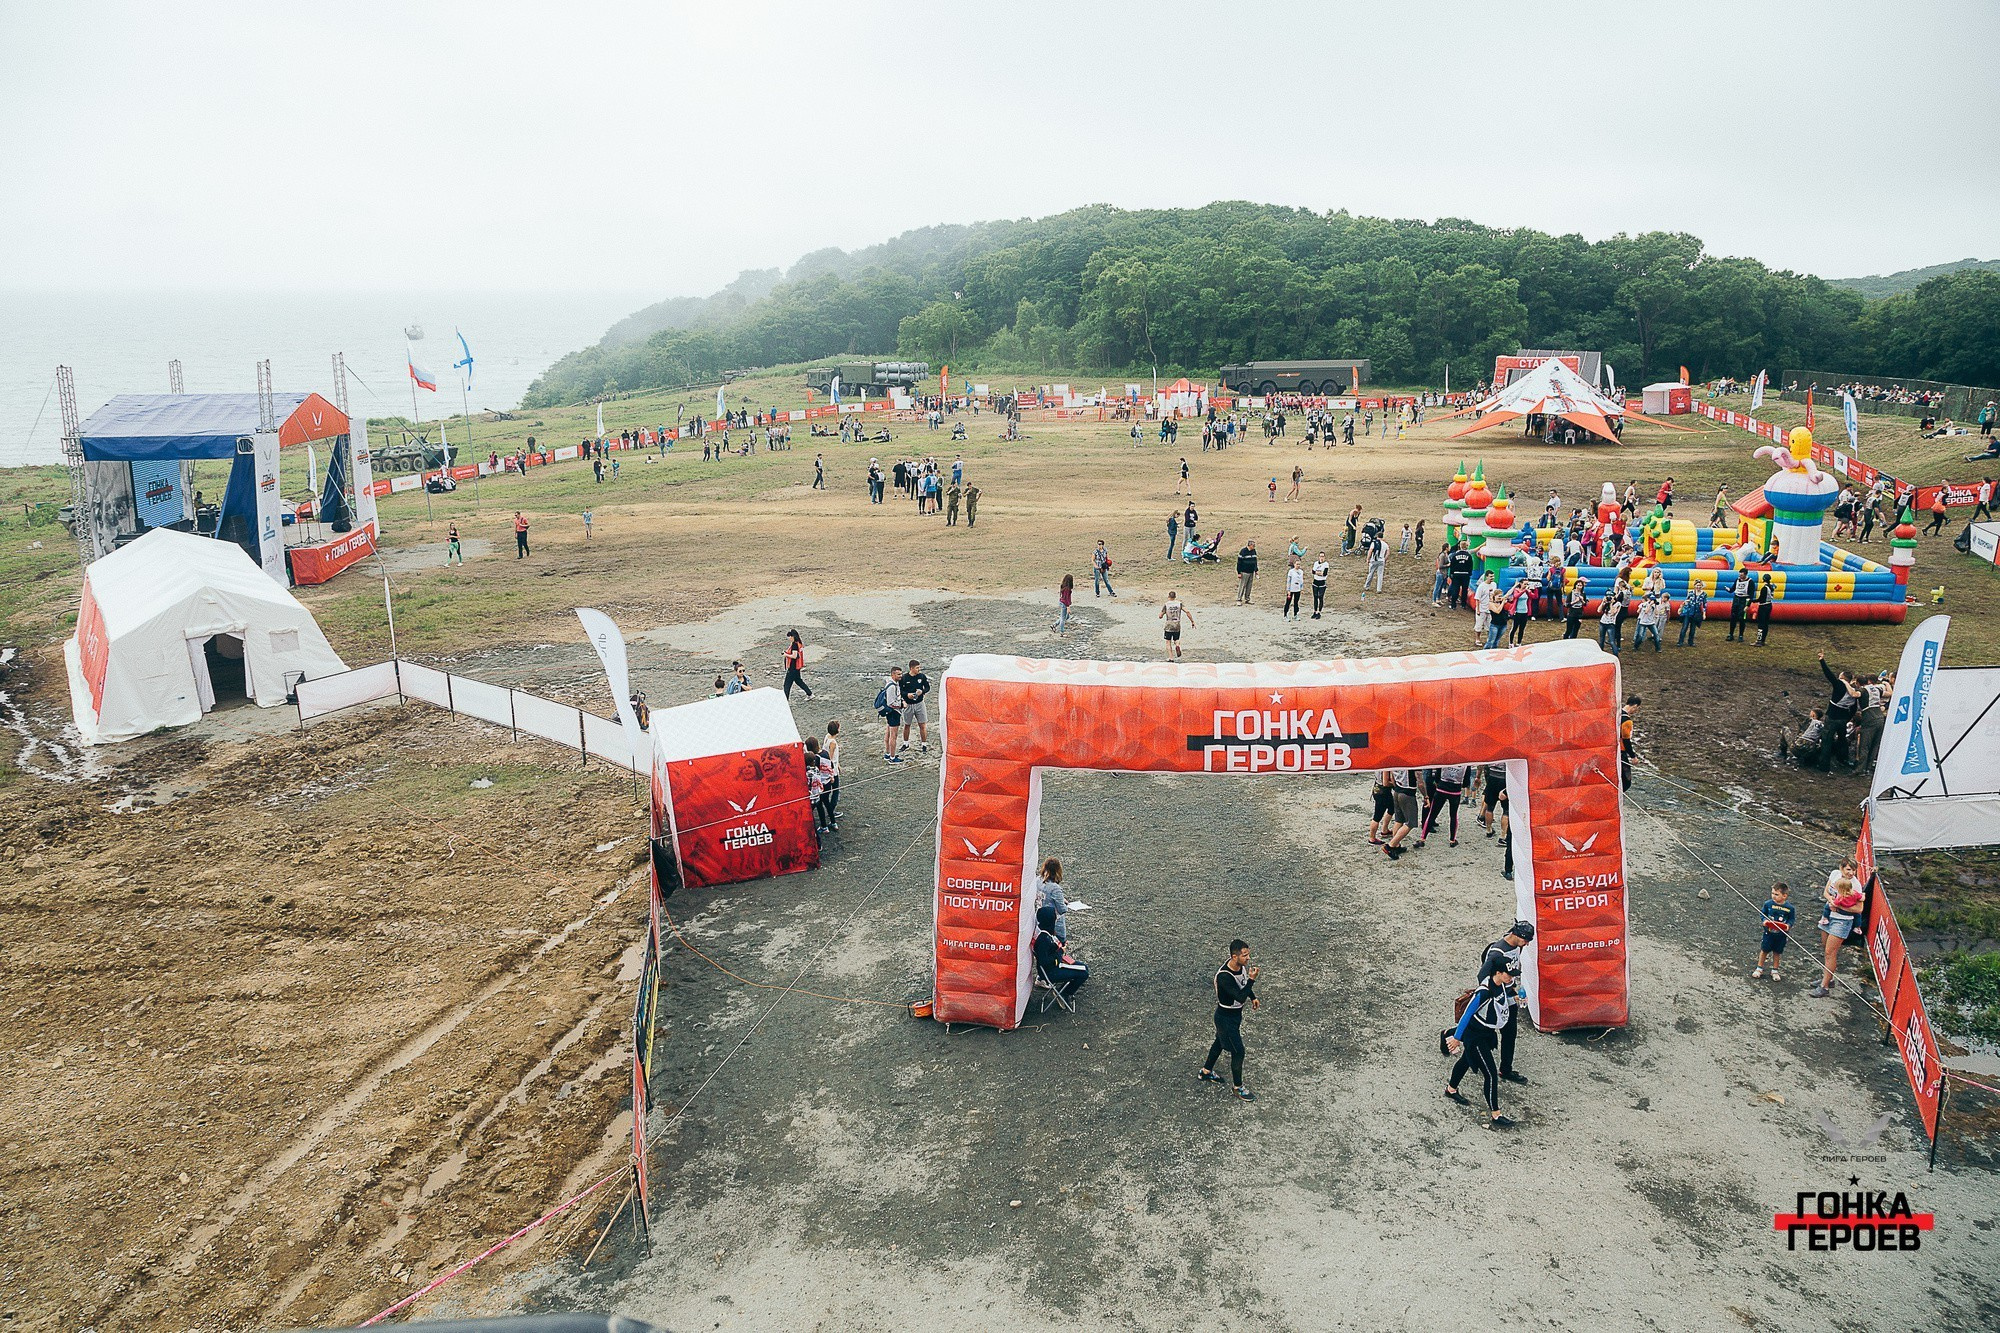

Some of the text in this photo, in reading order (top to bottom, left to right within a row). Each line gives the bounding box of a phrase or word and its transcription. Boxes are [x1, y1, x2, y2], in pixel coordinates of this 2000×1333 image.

[1519, 359, 1547, 369] СТАР
[331, 544, 349, 560] ГОНКА
[1213, 708, 1343, 741] ГОНКА
[1203, 743, 1352, 772] ГЕРОЕВ
[725, 823, 770, 840] ГОНКА
[724, 833, 773, 851] ГЕРОЕВ
[946, 877, 1013, 893] СОВЕРШИ
[1541, 872, 1618, 891] РАЗБУДИ
[943, 895, 1013, 911] ПОСТУПОК
[1554, 893, 1608, 911] ГЕРОЯ
[942, 938, 1012, 951] ЛИГАГЕРОЕВ.РФ
[1546, 938, 1621, 952] ЛИГАГЕРОЕВ.РФ
[1878, 914, 1891, 959] ГОНКА
[1873, 931, 1889, 980] ГЕРОЕВ
[1910, 1008, 1927, 1069] ГОНКА
[1903, 1027, 1925, 1094] ГЕРОЕВ
